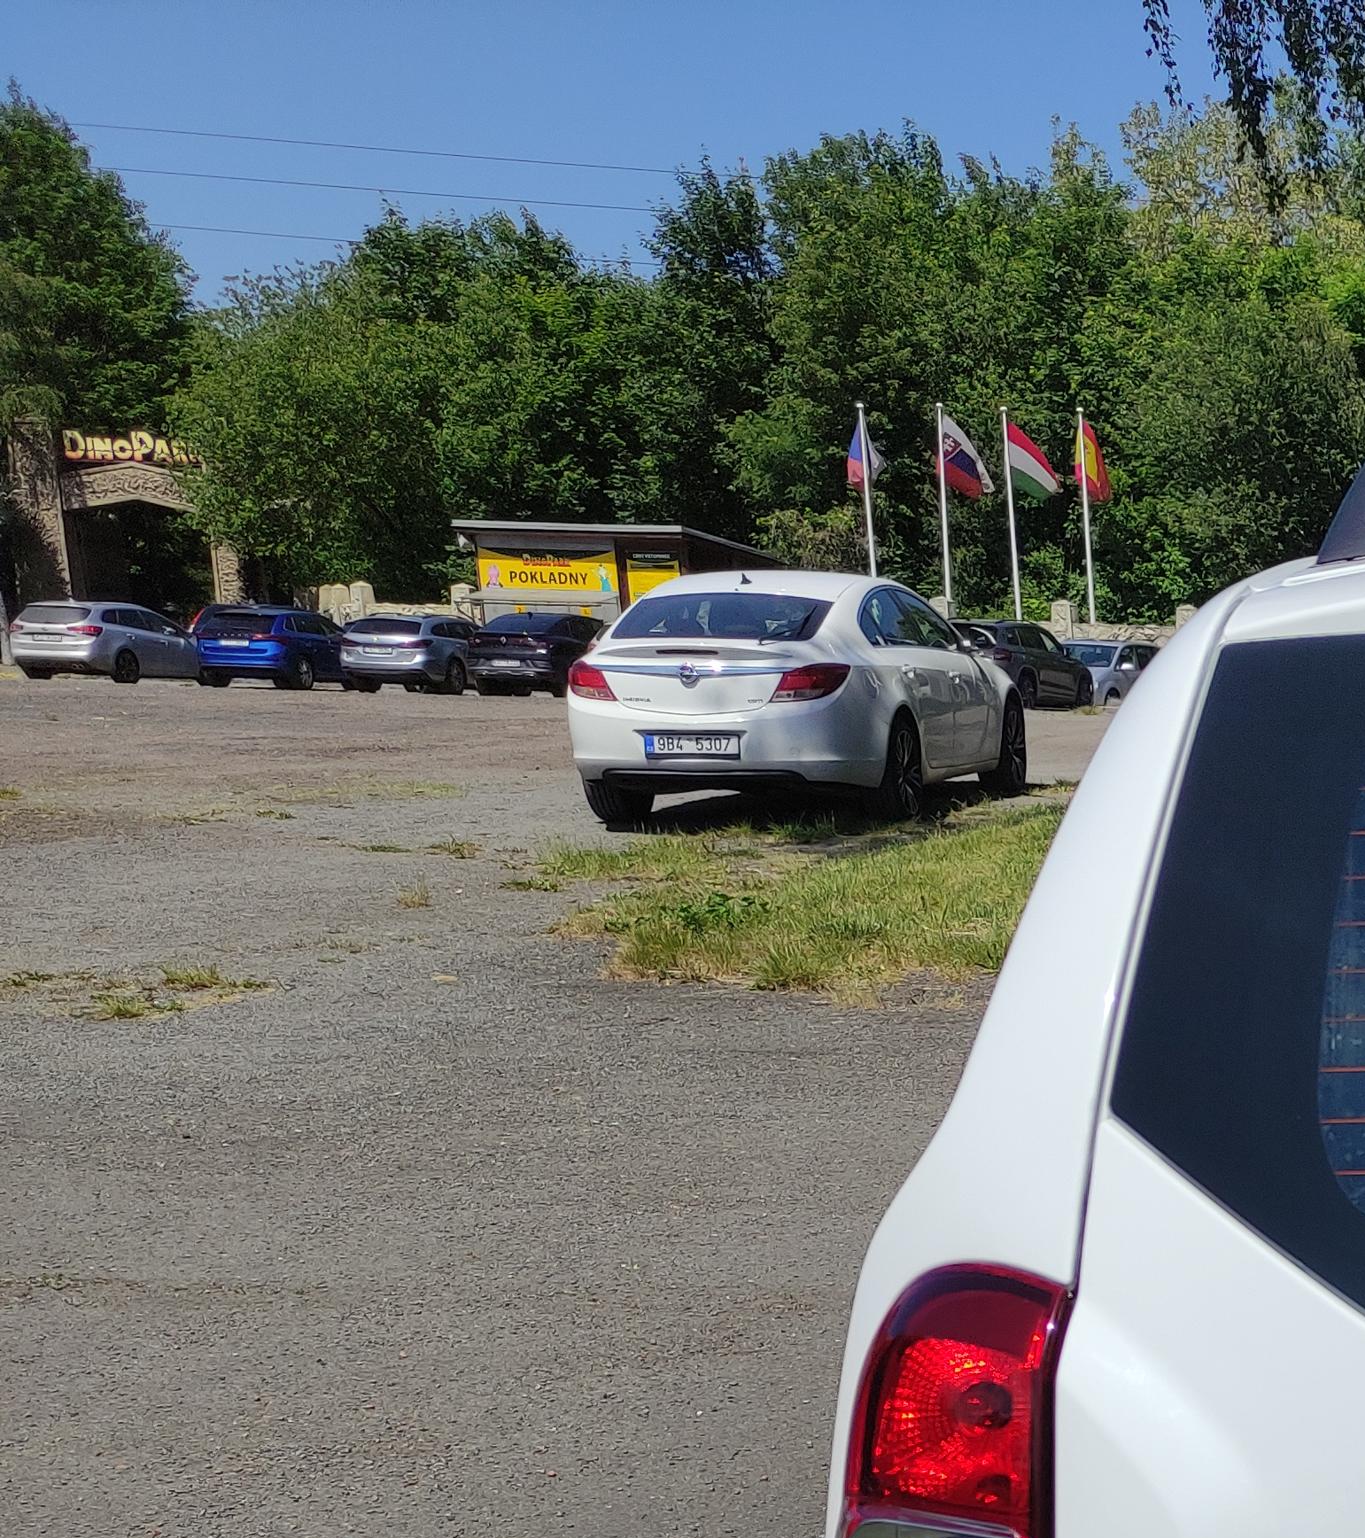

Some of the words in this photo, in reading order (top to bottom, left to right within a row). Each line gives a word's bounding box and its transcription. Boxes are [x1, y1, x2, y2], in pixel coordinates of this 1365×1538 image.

[509, 570, 588, 586] POKLADNY
[657, 737, 683, 752] 9B4
[695, 737, 731, 752] 5307
